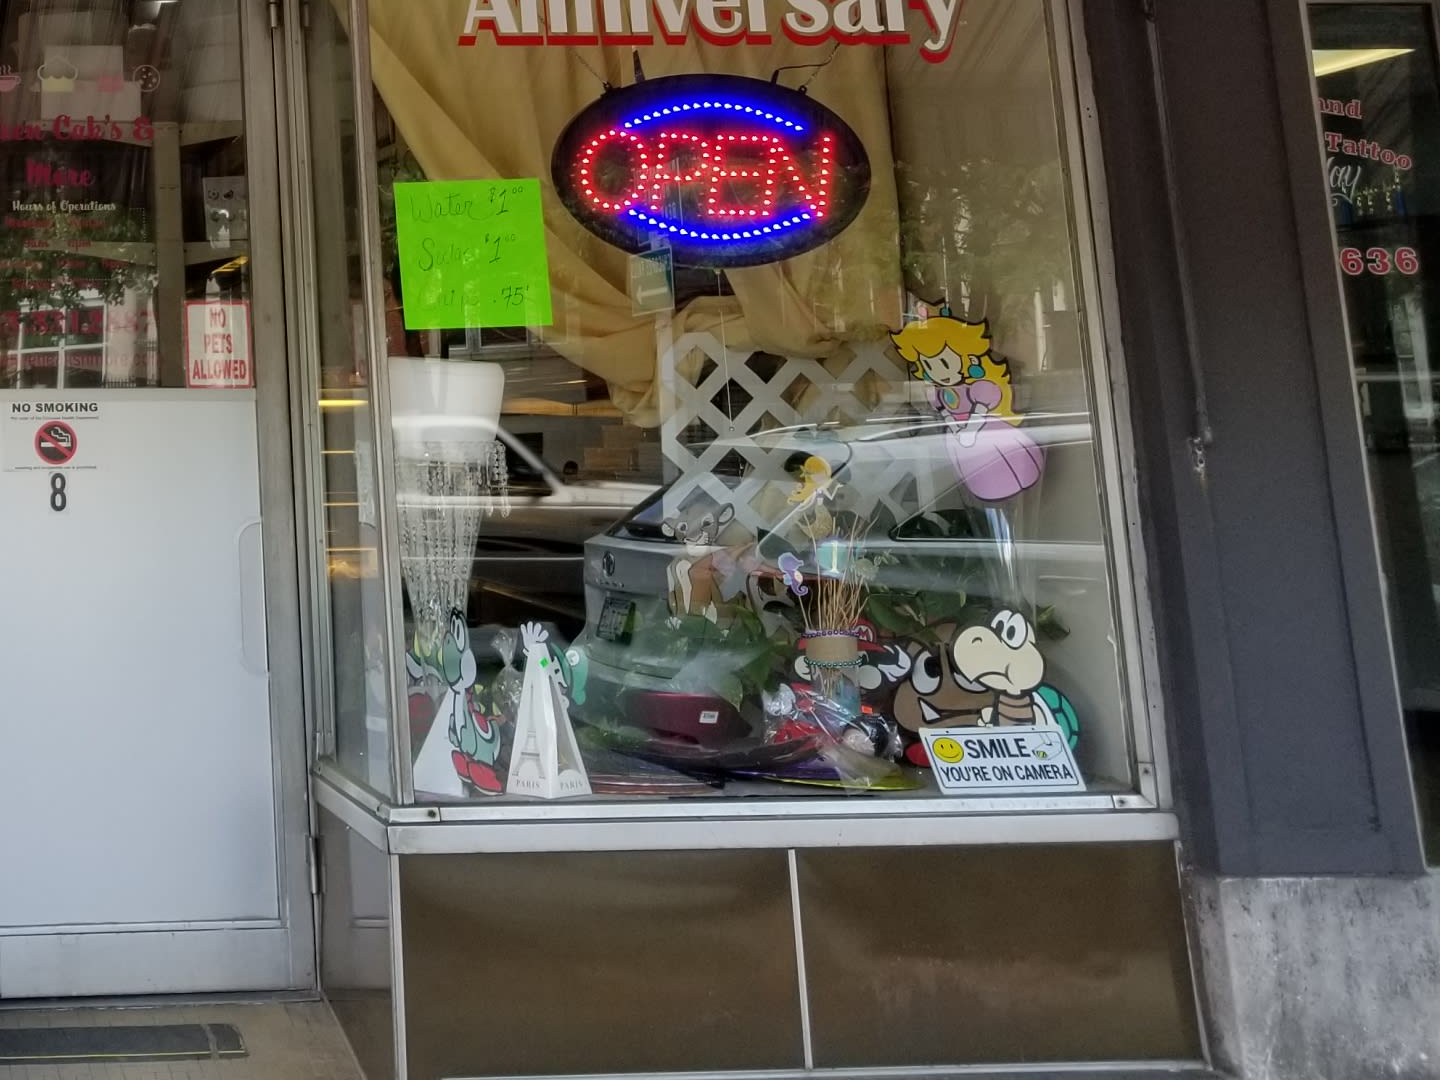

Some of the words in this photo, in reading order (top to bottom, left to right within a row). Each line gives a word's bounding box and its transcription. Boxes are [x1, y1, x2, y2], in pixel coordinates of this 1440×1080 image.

[1325, 132, 1412, 170] Tattoo
[579, 128, 834, 218] OPEN
[46, 200, 57, 213] of
[409, 192, 490, 223] Water
[1339, 248, 1419, 275] 636
[209, 308, 227, 329] NO
[203, 333, 233, 355] PETS
[192, 359, 247, 380] ALLOWED
[12, 403, 31, 413] NO
[35, 402, 99, 413] SMOKING
[49, 472, 67, 512] 8
[963, 737, 1032, 759] SMILE
[940, 765, 992, 783] YOU'RE
[992, 765, 1014, 781] ON
[1015, 763, 1073, 781] CAMERA
[516, 779, 541, 789] PARIS
[560, 780, 584, 790] PARIS
